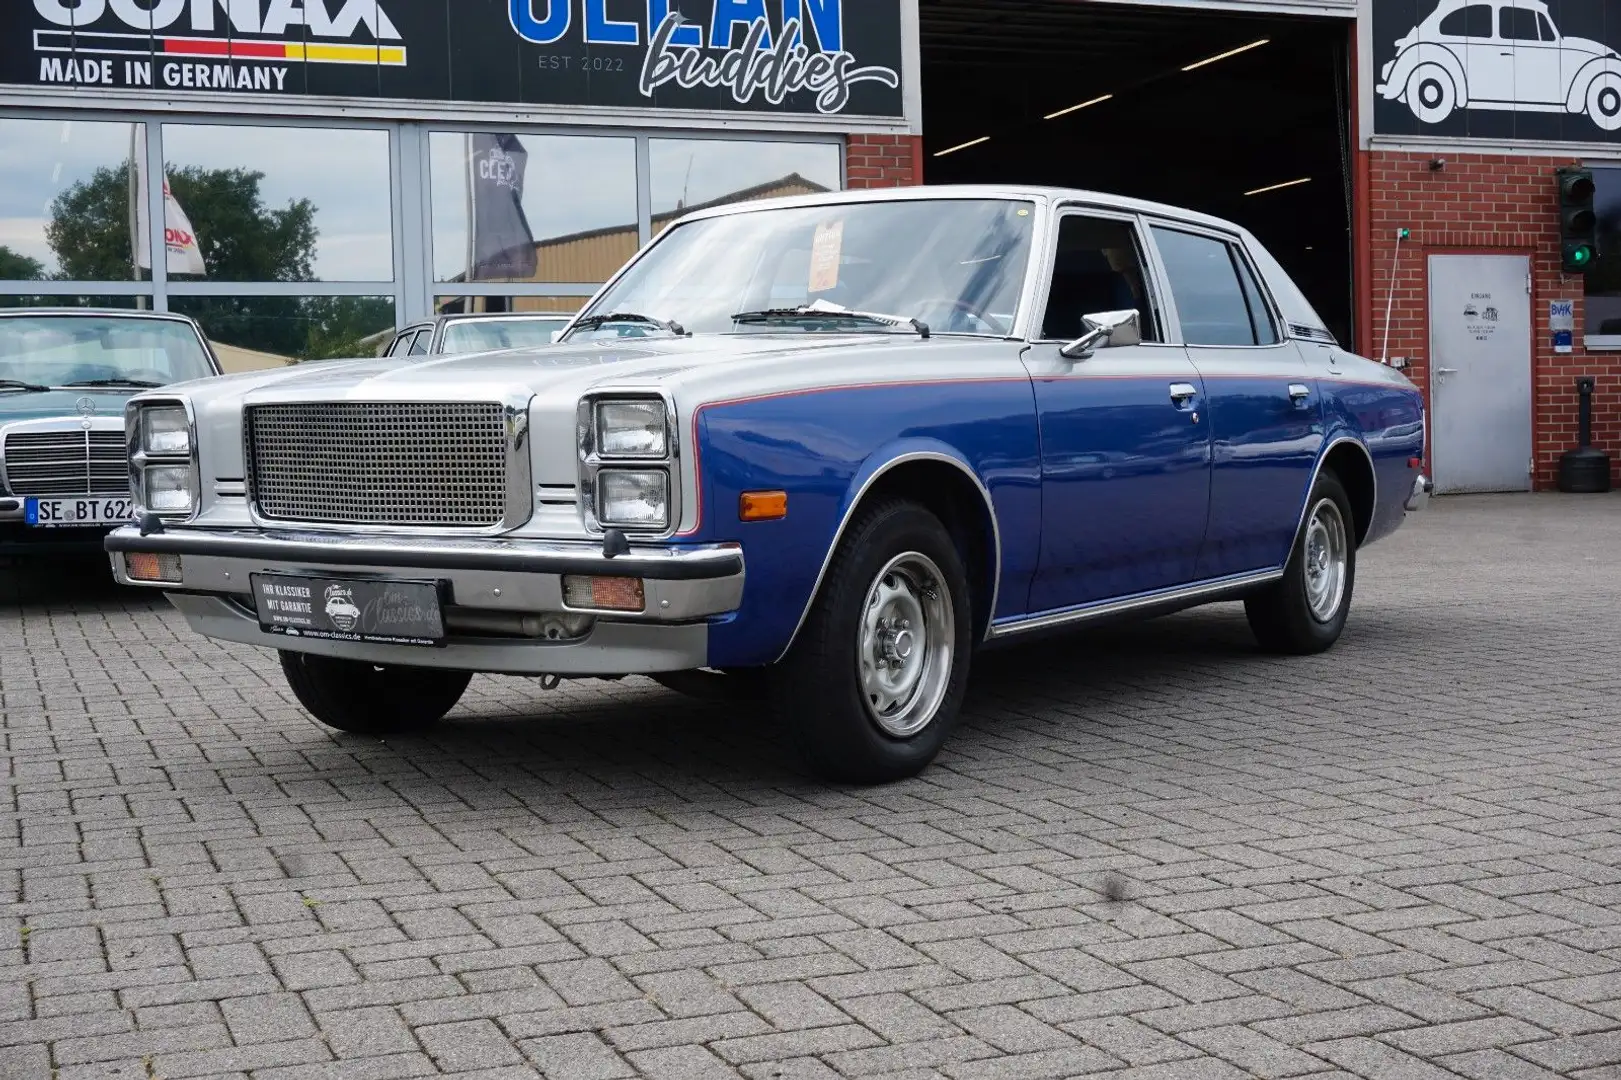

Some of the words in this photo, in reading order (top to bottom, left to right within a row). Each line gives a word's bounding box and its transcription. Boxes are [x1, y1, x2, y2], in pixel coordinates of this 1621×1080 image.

[538, 55, 570, 70] EST
[581, 56, 624, 72] 2022
[639, 11, 899, 114] buddies
[39, 57, 113, 84] MADE
[126, 61, 151, 86] IN
[163, 63, 288, 91] GERMANY
[39, 501, 63, 520] SE
[76, 500, 100, 520] BT
[262, 583, 274, 595] IHR
[274, 585, 311, 598] KLASSIKER
[267, 599, 279, 611] MIT
[280, 600, 312, 614] GARANTIE
